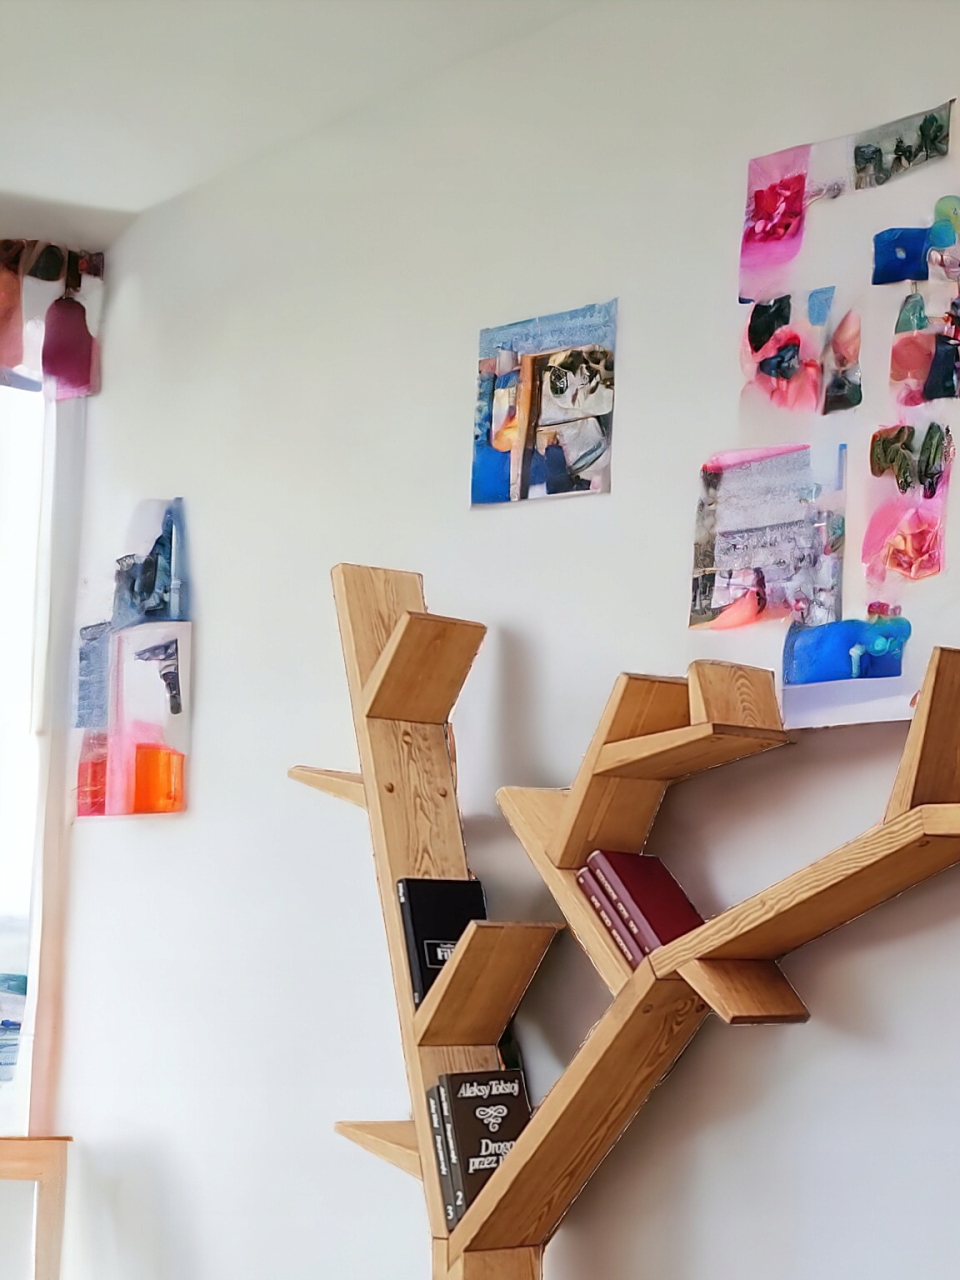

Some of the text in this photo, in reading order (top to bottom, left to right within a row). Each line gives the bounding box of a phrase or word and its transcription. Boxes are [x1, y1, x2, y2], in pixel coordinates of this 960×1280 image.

[457, 1082, 490, 1099] Aleksy
[468, 1156, 498, 1173] przez
[456, 1190, 463, 1206] 2
[446, 1205, 454, 1220] 3
